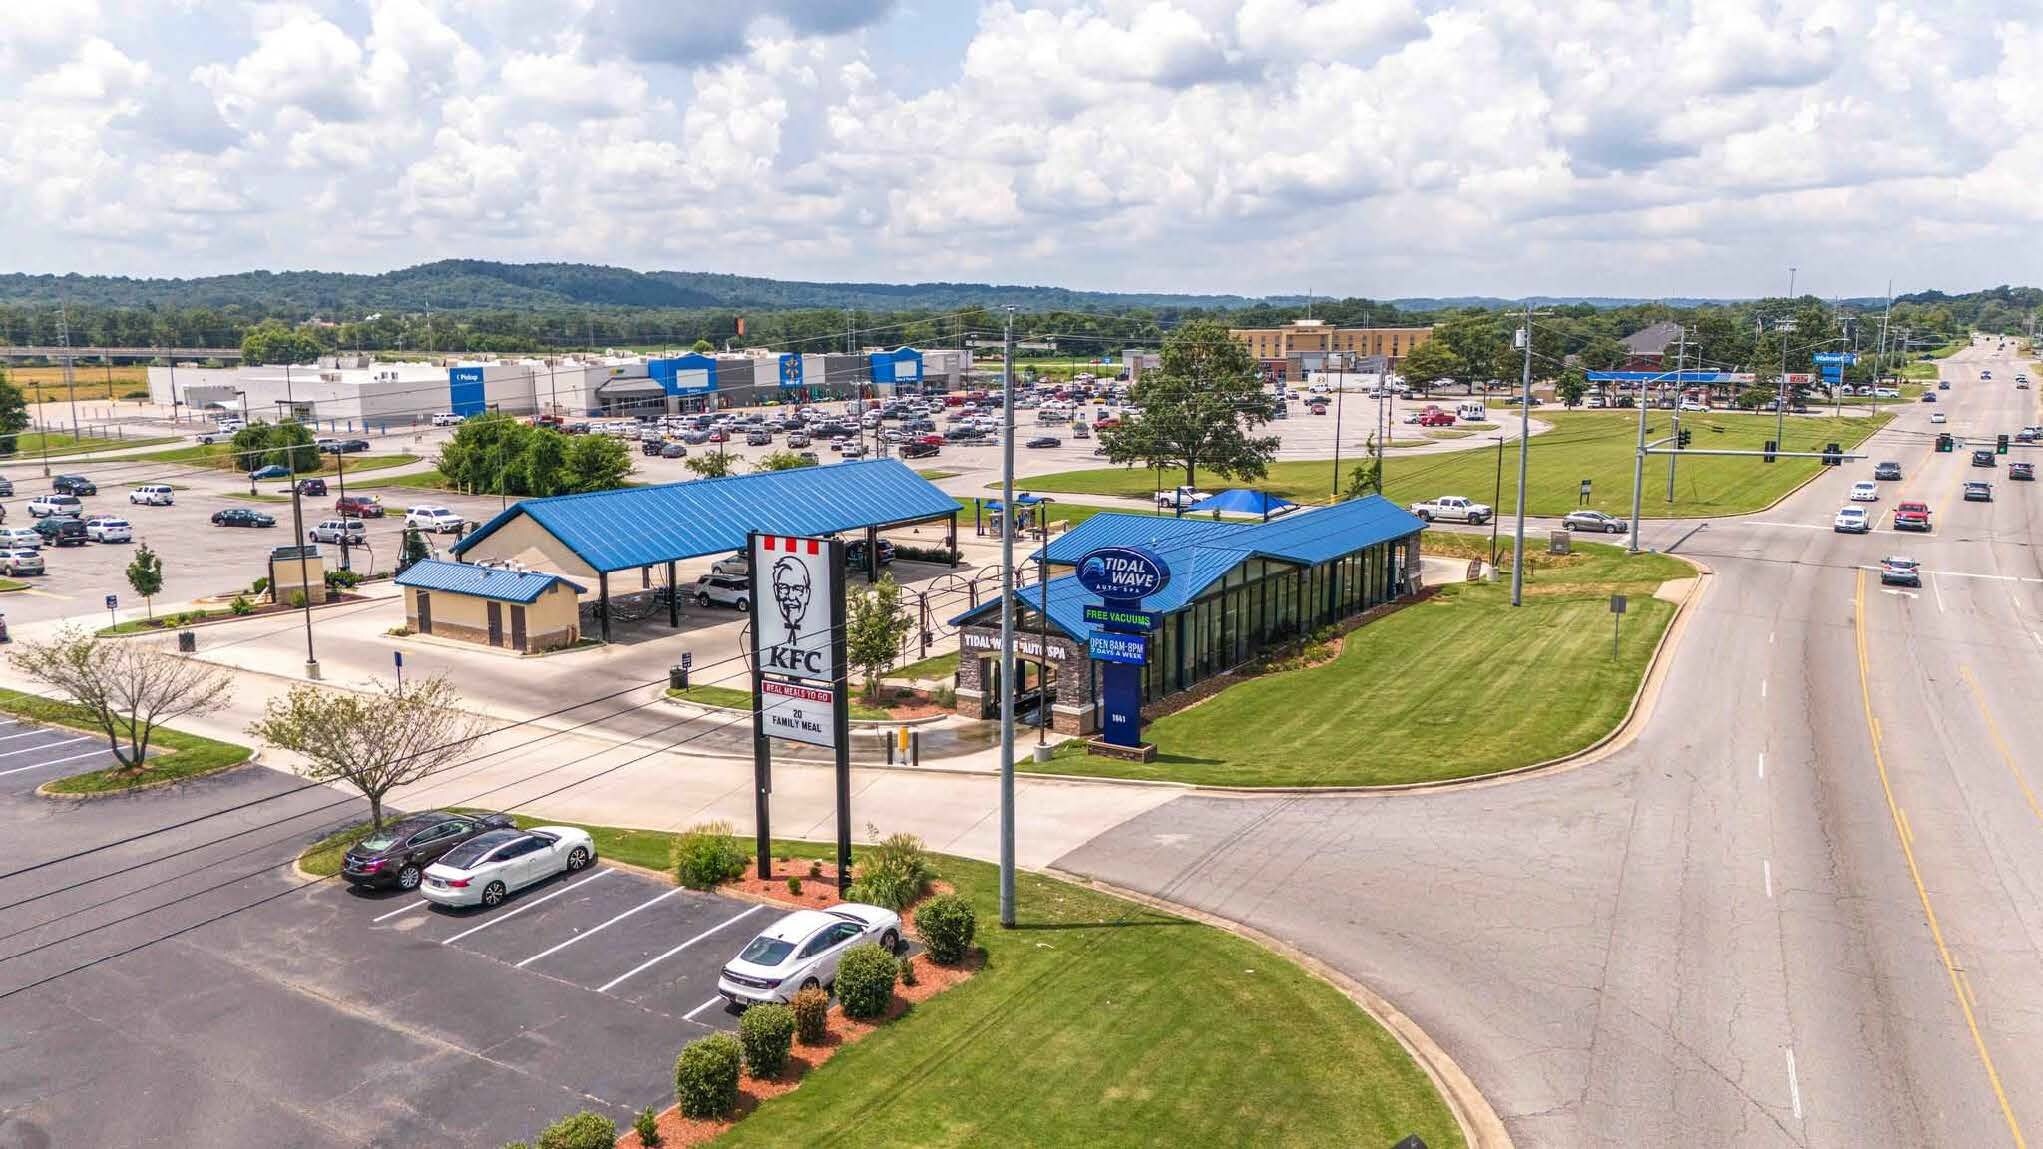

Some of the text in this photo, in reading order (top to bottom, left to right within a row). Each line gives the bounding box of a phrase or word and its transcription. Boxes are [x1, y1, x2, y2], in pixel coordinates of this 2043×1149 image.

[1105, 557, 1145, 573] TIDAL
[1112, 571, 1154, 587] WAVE
[1096, 583, 1118, 592] AUTO
[1086, 609, 1151, 626] FREE VACUUMS
[964, 634, 991, 649] TIDAL
[1047, 645, 1066, 660] SPA
[1090, 637, 1109, 650] OPEN
[769, 646, 822, 673] KFC
[1097, 648, 1114, 656] DAYS
[766, 683, 828, 702] REAL MEALS TO GO
[793, 709, 803, 719] 20
[773, 716, 822, 732] FAMILY MEAL
